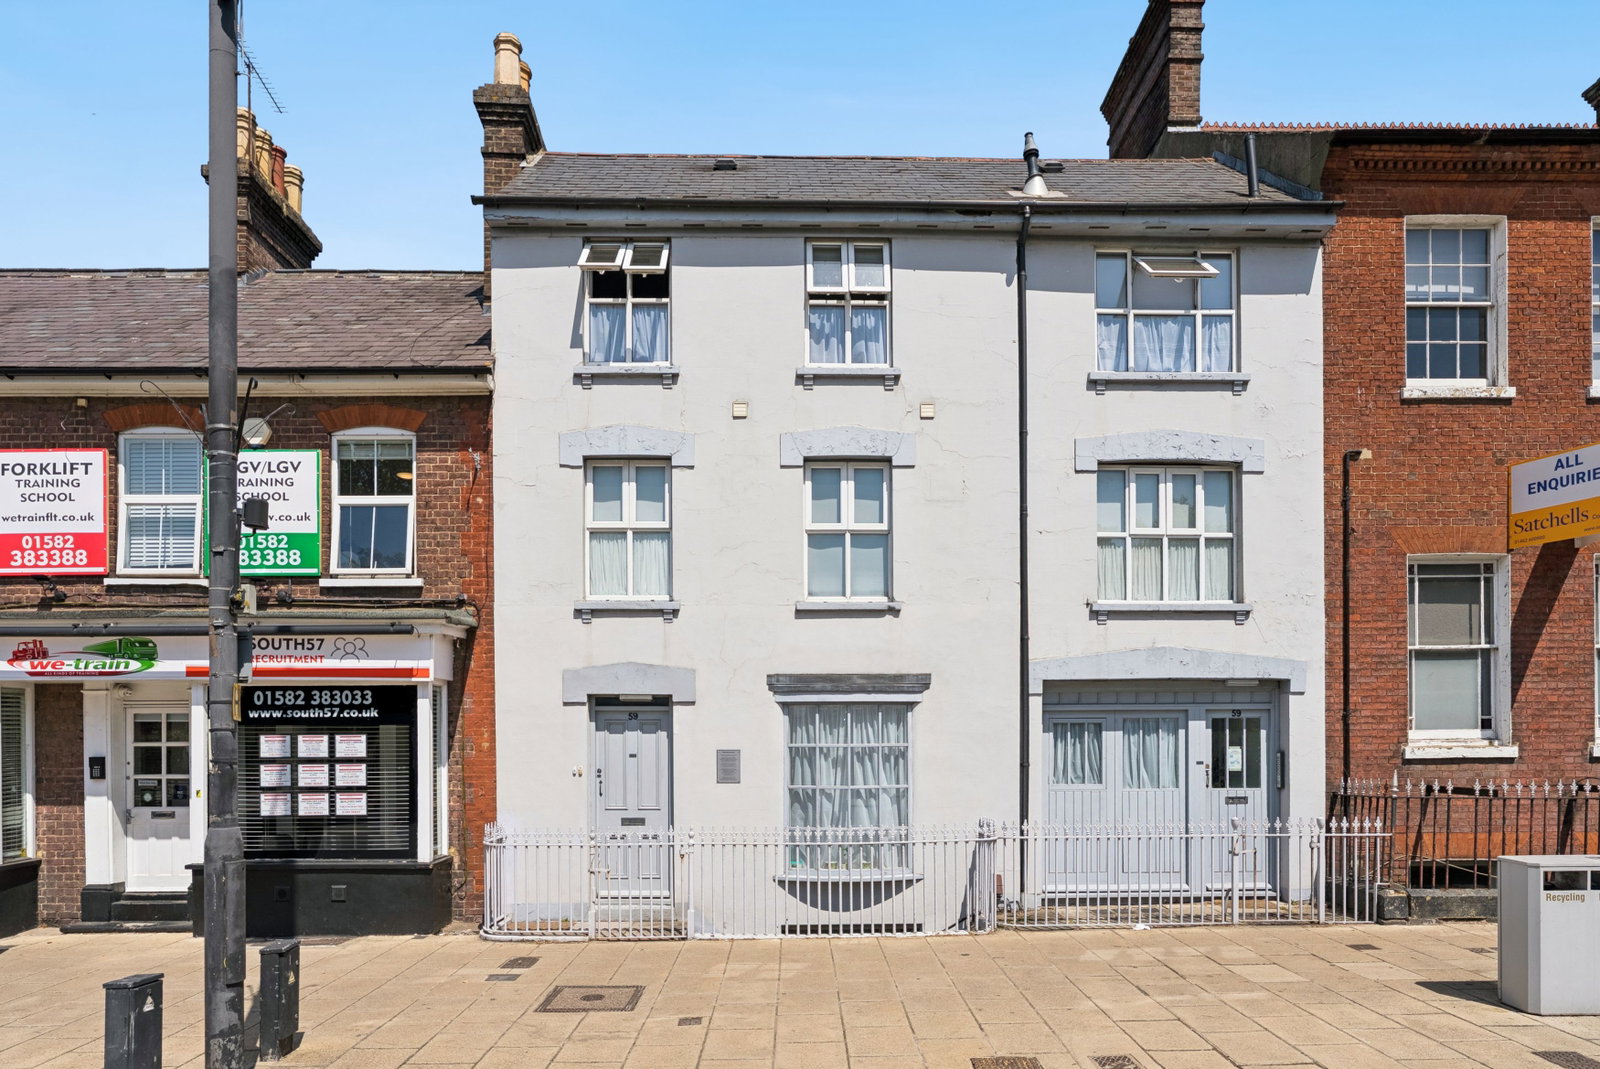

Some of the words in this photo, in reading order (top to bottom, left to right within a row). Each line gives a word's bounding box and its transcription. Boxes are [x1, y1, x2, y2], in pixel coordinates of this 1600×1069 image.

[237, 461, 301, 474] GV/LGV
[1554, 454, 1583, 471] ALL
[1, 462, 93, 476] FORKLIFT
[15, 478, 81, 488] TRAINING
[238, 477, 294, 487] RAINING
[1528, 467, 1600, 495] ENQUIRIE
[20, 492, 76, 503] SCHOOL
[1, 512, 95, 523] wetrainflt.co.uk
[1514, 506, 1589, 534] Satchells
[21, 535, 75, 549] 01582
[10, 549, 88, 566] 383388
[239, 549, 301, 566] 83388
[29, 658, 131, 670] we-train
[253, 690, 306, 705] 01582
[310, 690, 373, 705] 383033
[248, 707, 379, 718] www.south57.co.uk
[628, 712, 639, 721] 59
[1231, 709, 1242, 718] 59
[1545, 892, 1585, 903] Recycling
